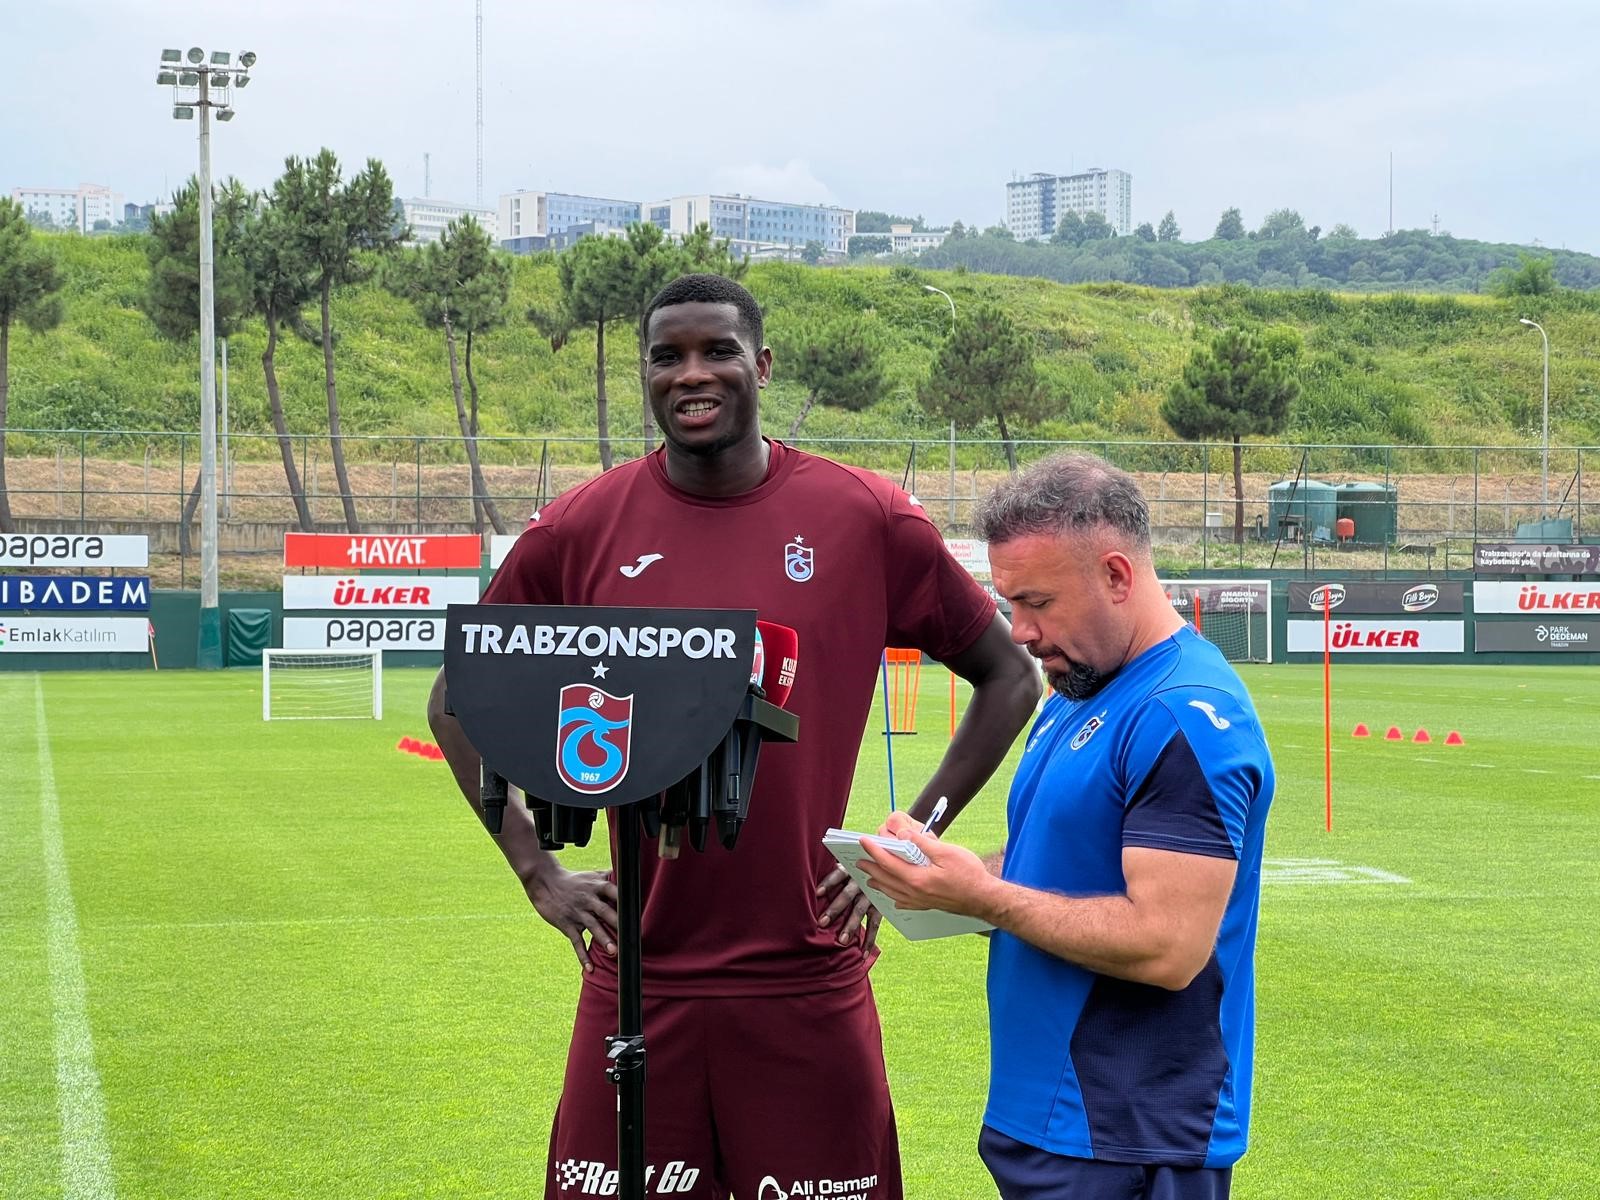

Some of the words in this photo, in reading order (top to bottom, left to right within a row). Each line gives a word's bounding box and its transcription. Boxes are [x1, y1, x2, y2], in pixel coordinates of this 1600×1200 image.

[347, 538, 428, 564] HAYAT
[333, 579, 431, 605] ÜLKER
[1170, 598, 1188, 606] sko
[1518, 585, 1600, 610] ÜLKER
[326, 620, 435, 647] papara
[461, 624, 737, 659] TRABZONSPOR
[1332, 623, 1420, 648] ÜLKER
[1550, 633, 1588, 641] DEDEMAN
[580, 772, 601, 782] 1967
[581, 1161, 656, 1195] Ret
[656, 1161, 700, 1194] Go
[790, 1180, 814, 1196] Ali
[818, 1174, 878, 1194] Osman
